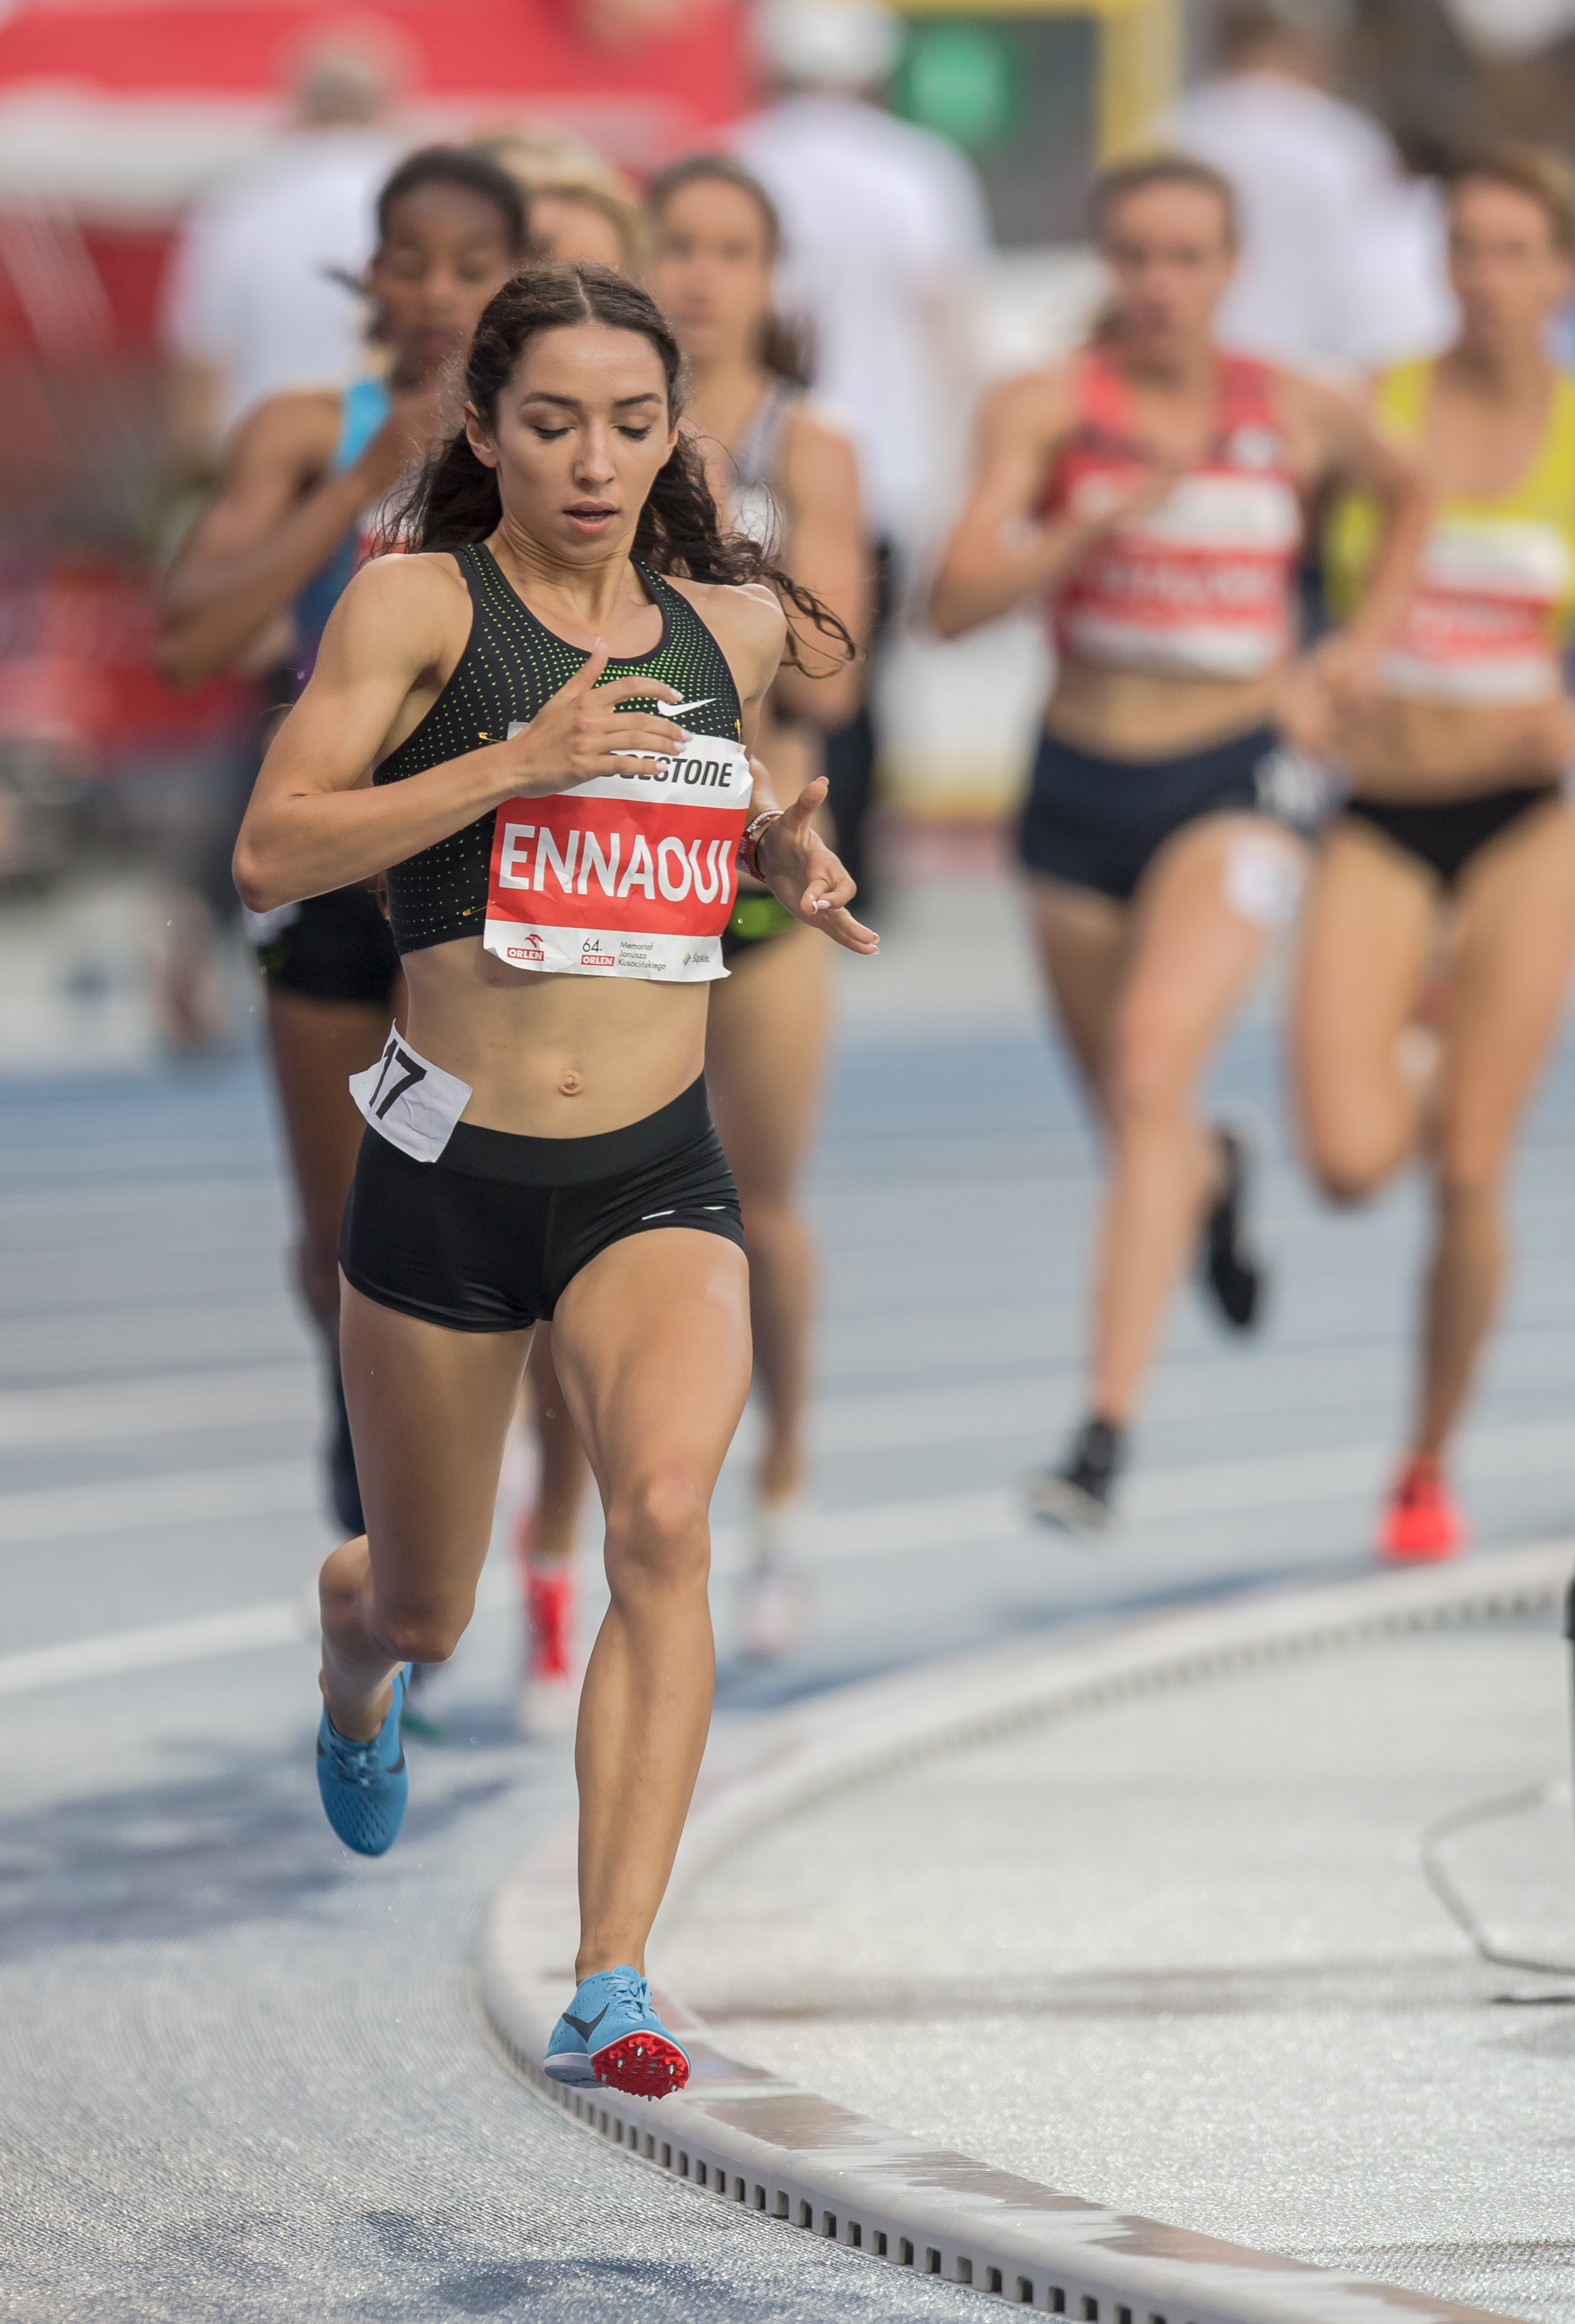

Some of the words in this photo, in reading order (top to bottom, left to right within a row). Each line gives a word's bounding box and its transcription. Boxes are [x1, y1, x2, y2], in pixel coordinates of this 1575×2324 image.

[499, 823, 732, 904] ENNAOUI
[620, 941, 653, 950] Memorial
[509, 948, 543, 960] ORLEN
[618, 950, 647, 959] Janusza
[583, 956, 613, 965] ORLEN
[618, 958, 666, 971] Kusocińskiego
[369, 1038, 428, 1121] 17
